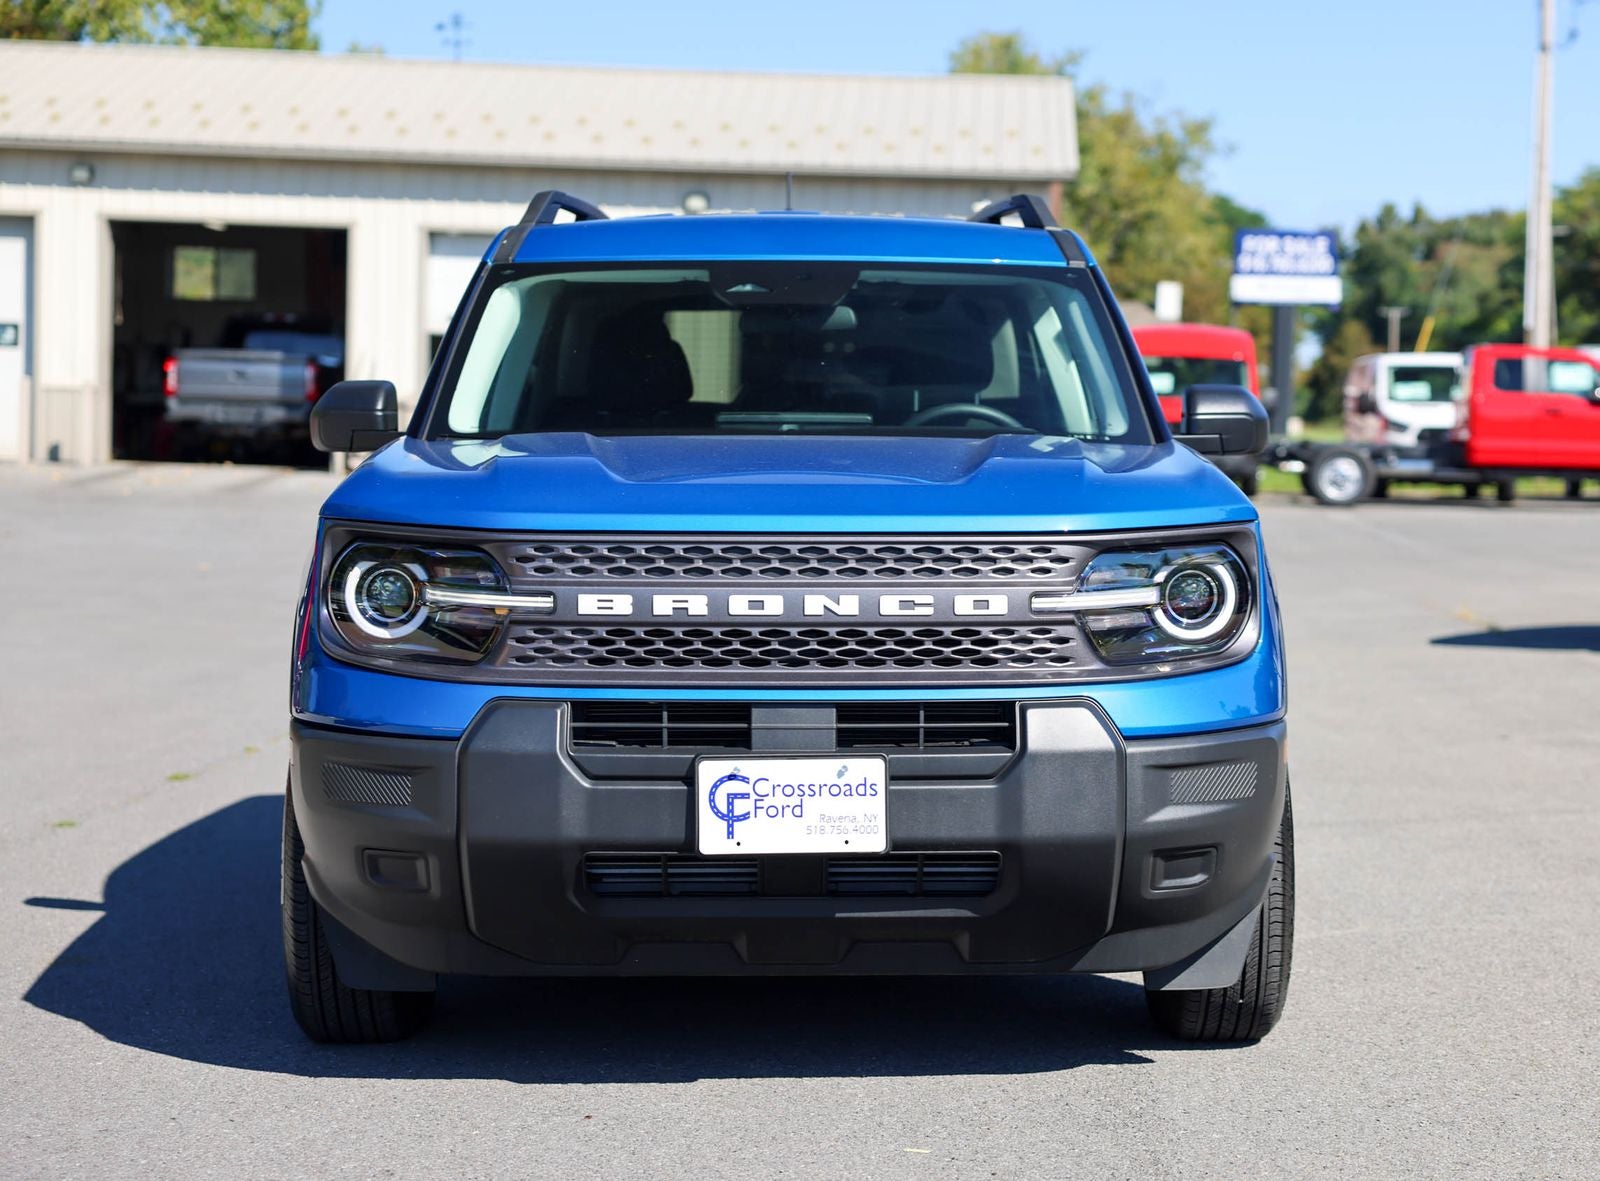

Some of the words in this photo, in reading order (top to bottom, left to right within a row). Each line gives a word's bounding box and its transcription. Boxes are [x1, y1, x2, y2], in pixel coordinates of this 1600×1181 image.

[577, 593, 1009, 616] BRONCO
[753, 777, 878, 797] Crossroads
[754, 798, 803, 818] Ford
[863, 813, 878, 823] NY
[806, 824, 879, 835] 518.756.4000
